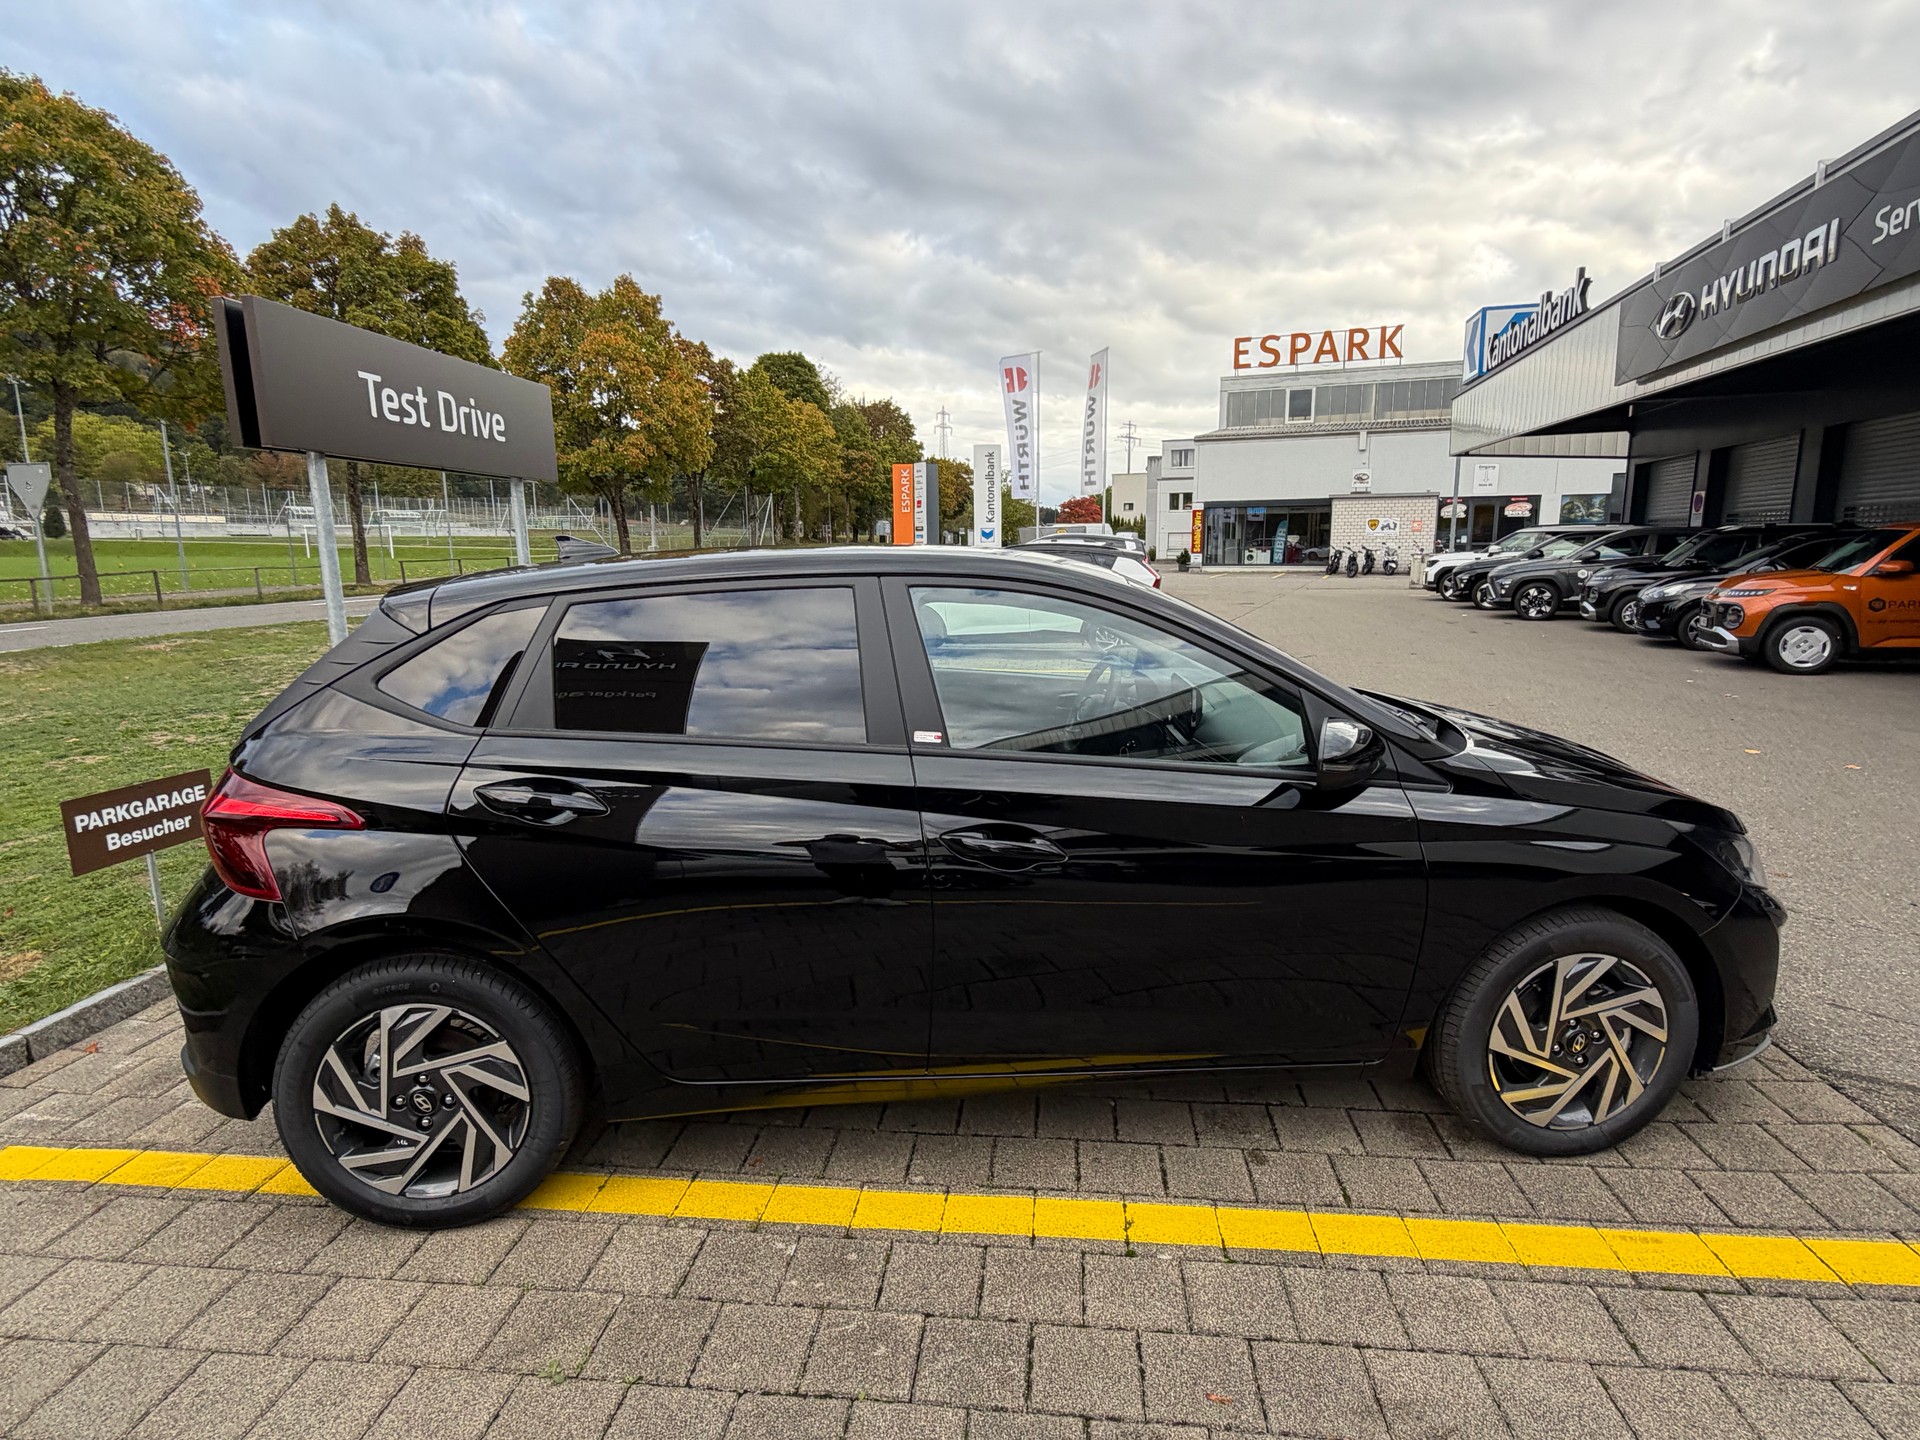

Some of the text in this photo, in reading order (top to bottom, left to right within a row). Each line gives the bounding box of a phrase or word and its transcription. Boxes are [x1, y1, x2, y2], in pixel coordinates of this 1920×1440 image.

[1872, 199, 1920, 245] Ser
[1700, 217, 1842, 320] HYUNDAI
[1482, 267, 1592, 373] Kantonalbank
[1233, 323, 1405, 369] ESPARK
[357, 370, 506, 443] Test Drive
[900, 468, 911, 513] ESPARK
[985, 451, 995, 523] Kantonalbank
[1888, 600, 1920, 609] PAR
[74, 784, 206, 834] PARKGARAGE
[106, 814, 193, 851] Besucher
